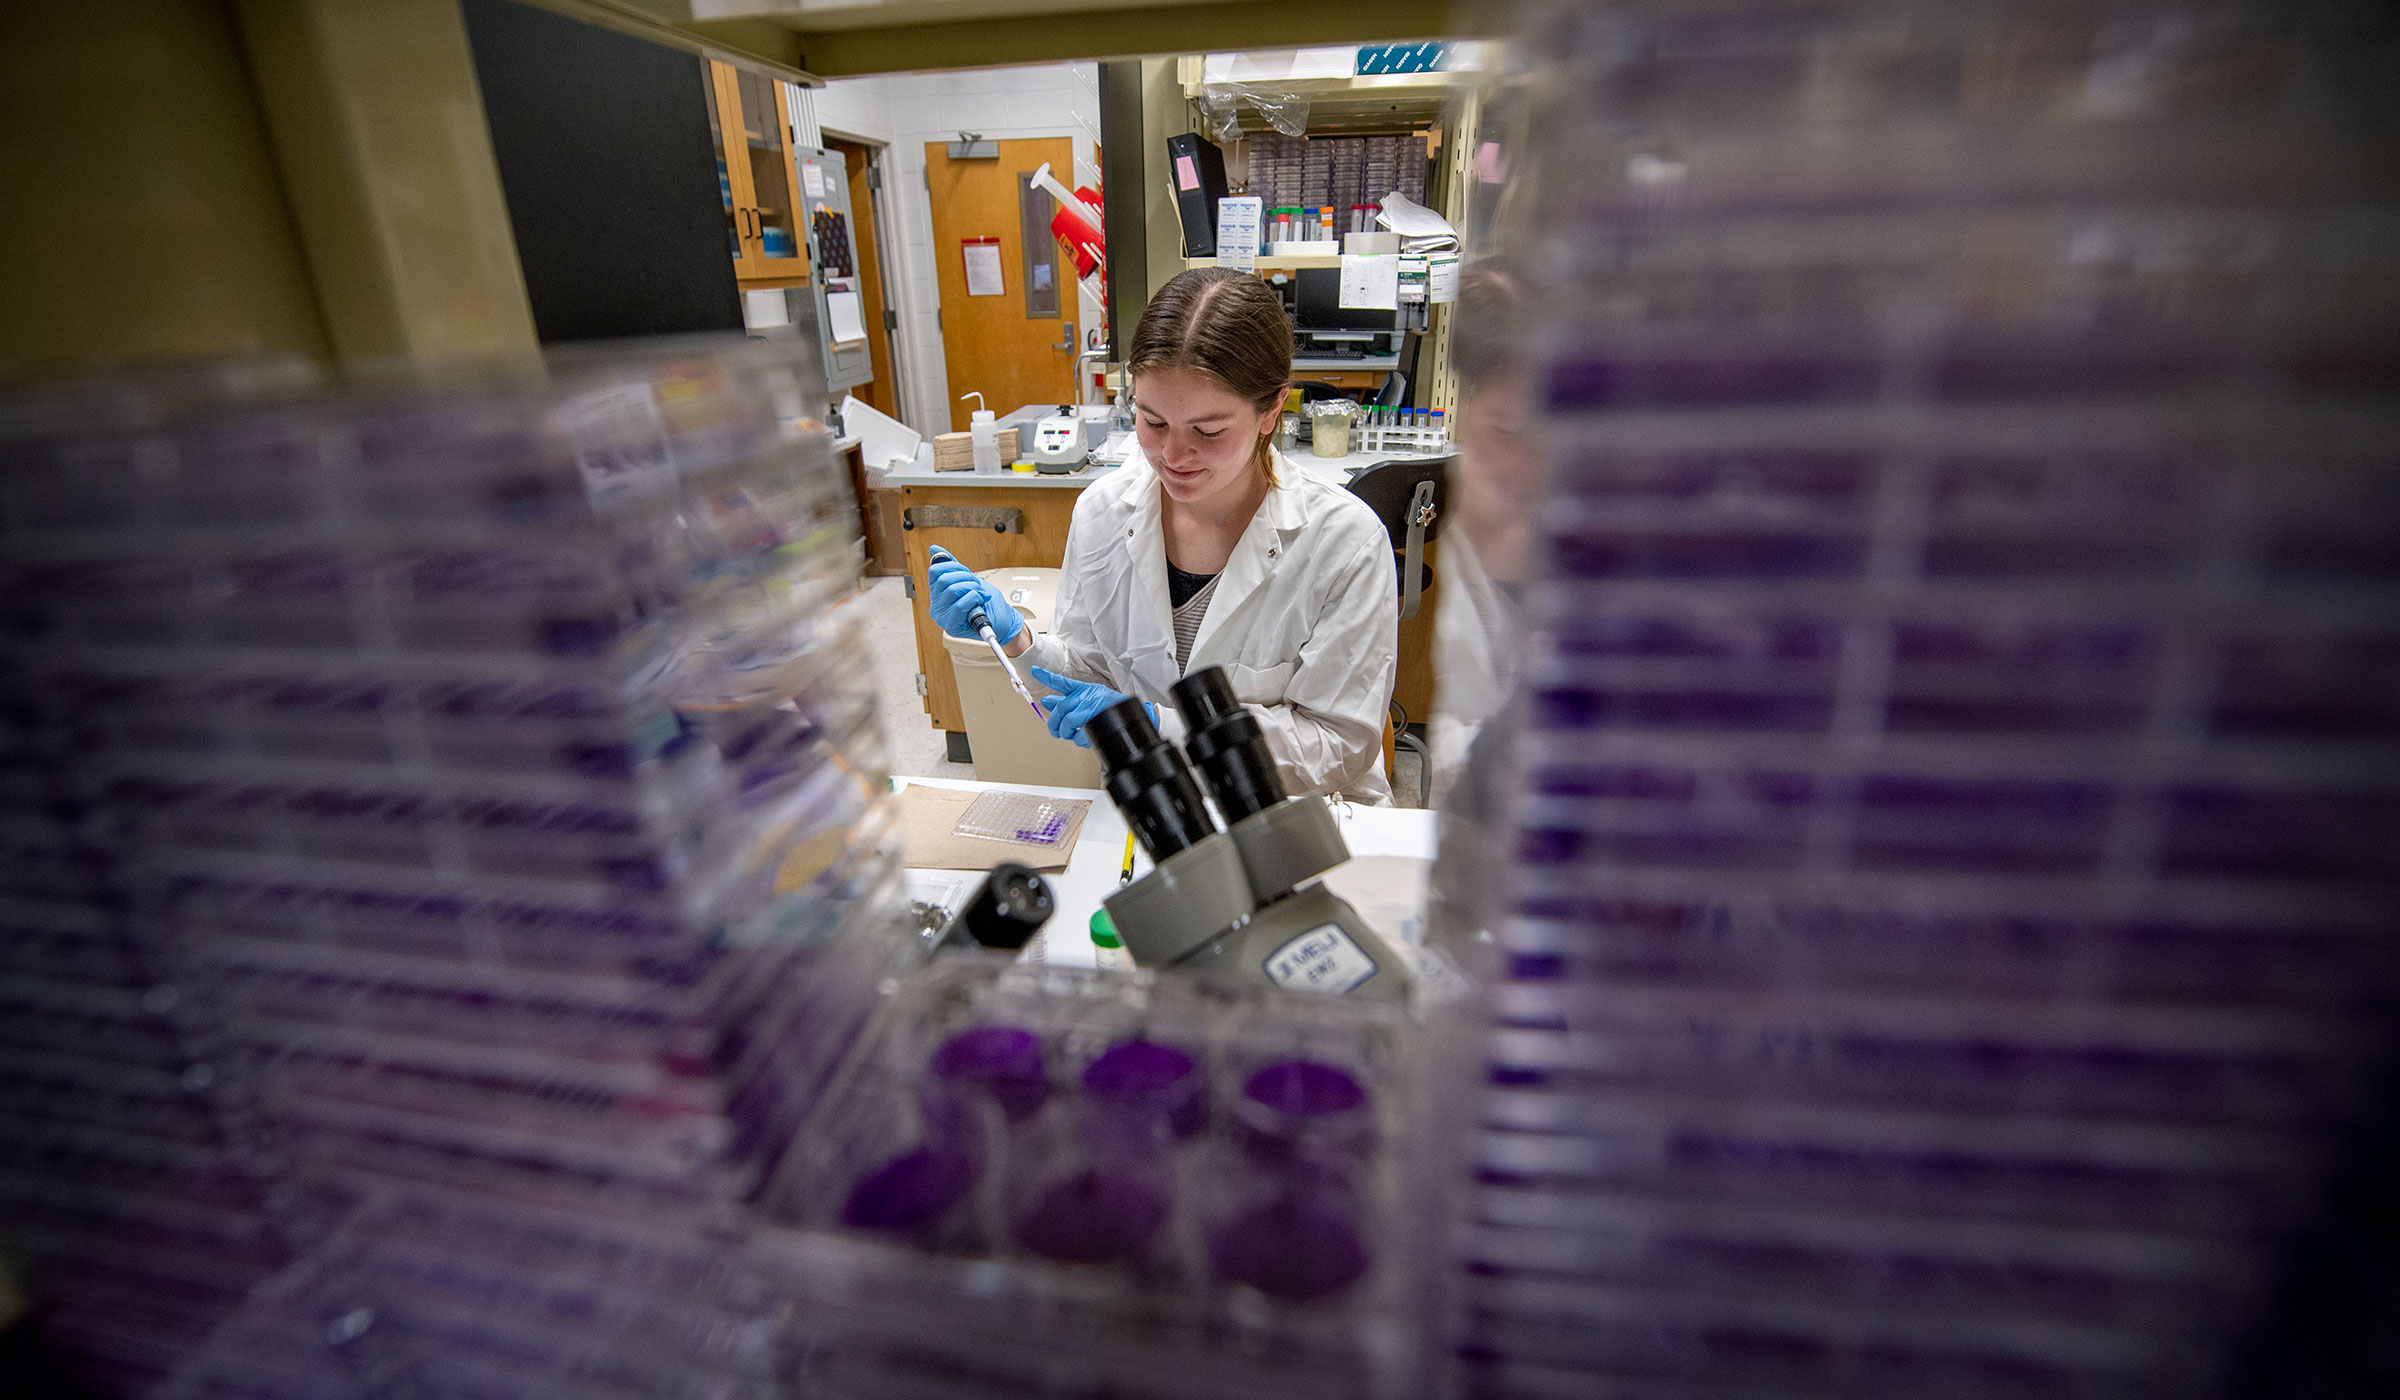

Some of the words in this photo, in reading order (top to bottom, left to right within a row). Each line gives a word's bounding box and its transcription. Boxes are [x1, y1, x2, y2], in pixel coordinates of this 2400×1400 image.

[1362, 52, 1378, 71] QIAGEN
[1395, 51, 1411, 70] QIAGEN
[1413, 62, 1423, 73] QIA
[1429, 49, 1444, 68] QIAGEN
[1380, 64, 1390, 74] GEN
